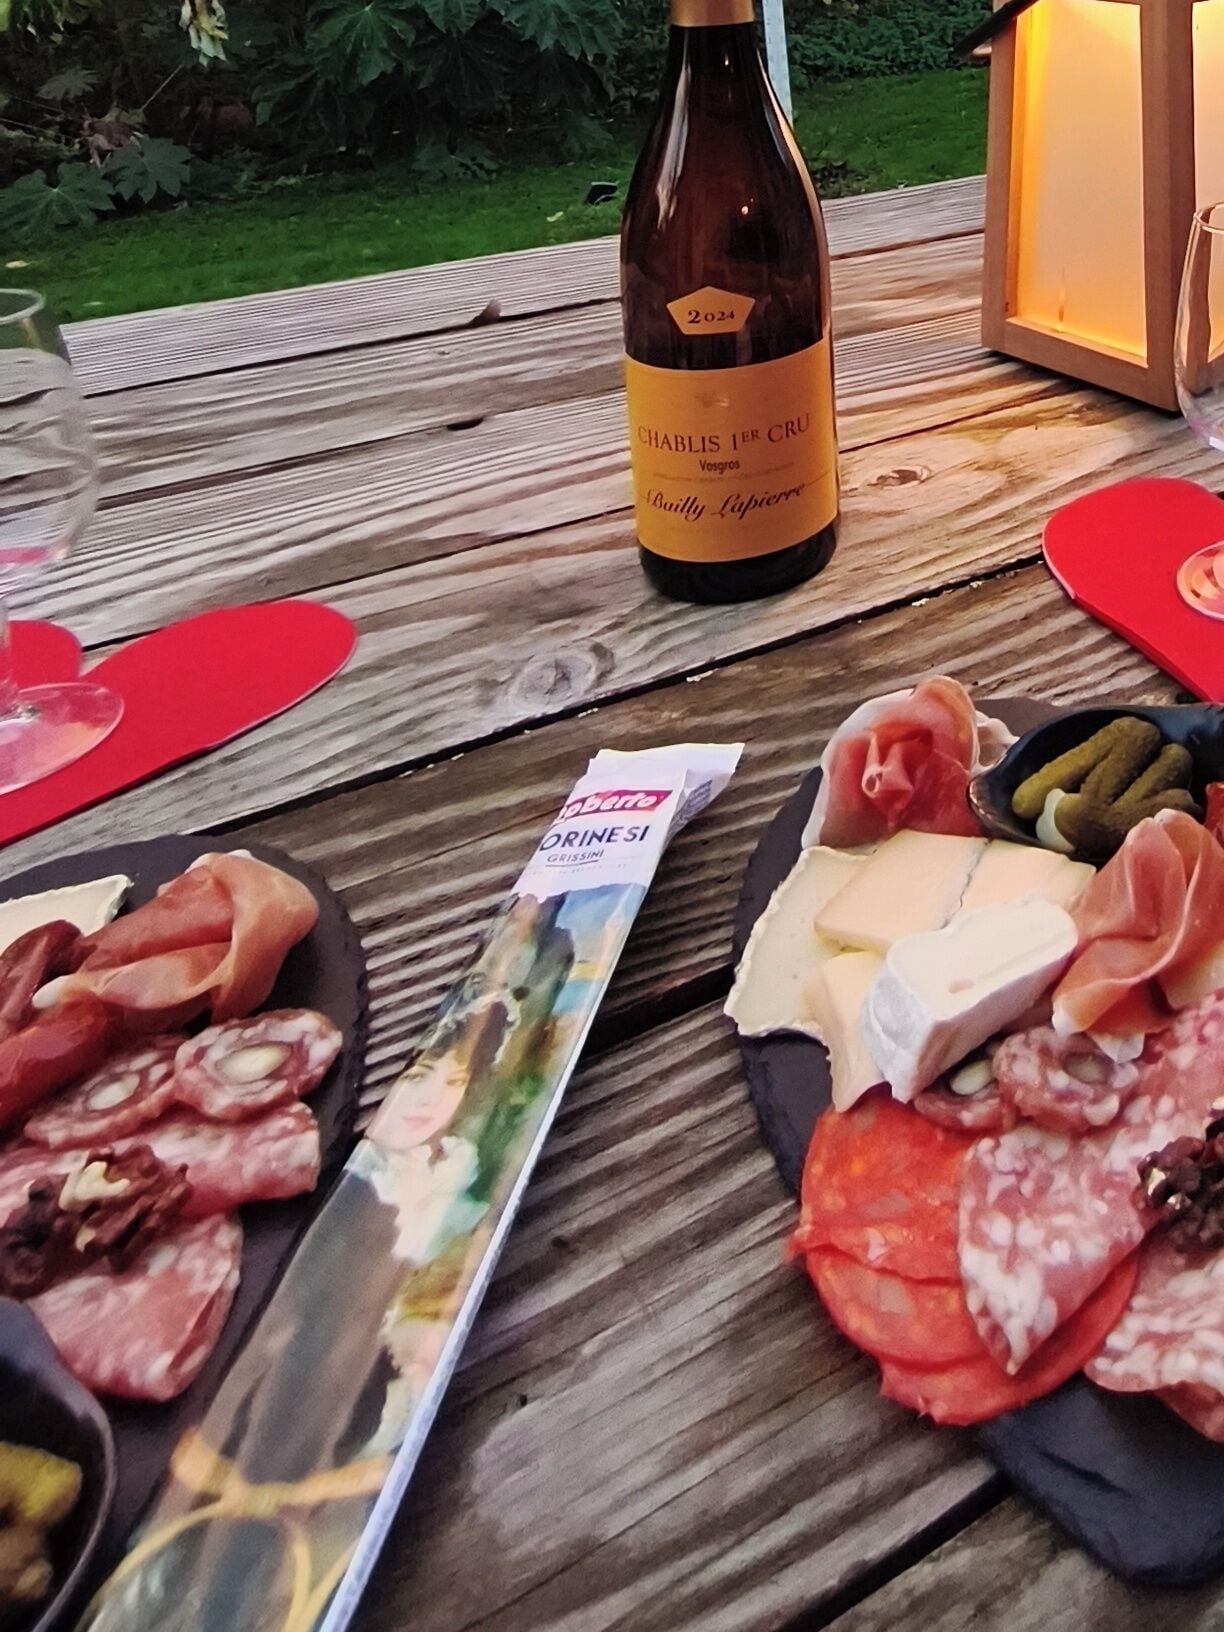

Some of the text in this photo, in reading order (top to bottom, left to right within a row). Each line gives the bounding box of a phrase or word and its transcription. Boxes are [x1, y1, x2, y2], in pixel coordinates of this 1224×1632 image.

[687, 309, 736, 325] 2024
[637, 427, 721, 453] CHABLIS
[767, 413, 811, 444] CRU
[699, 459, 741, 474] Vosgros
[646, 483, 806, 522] Bailly Lapierre
[539, 824, 650, 852] ORINESI
[547, 849, 605, 863] GRISSINI
